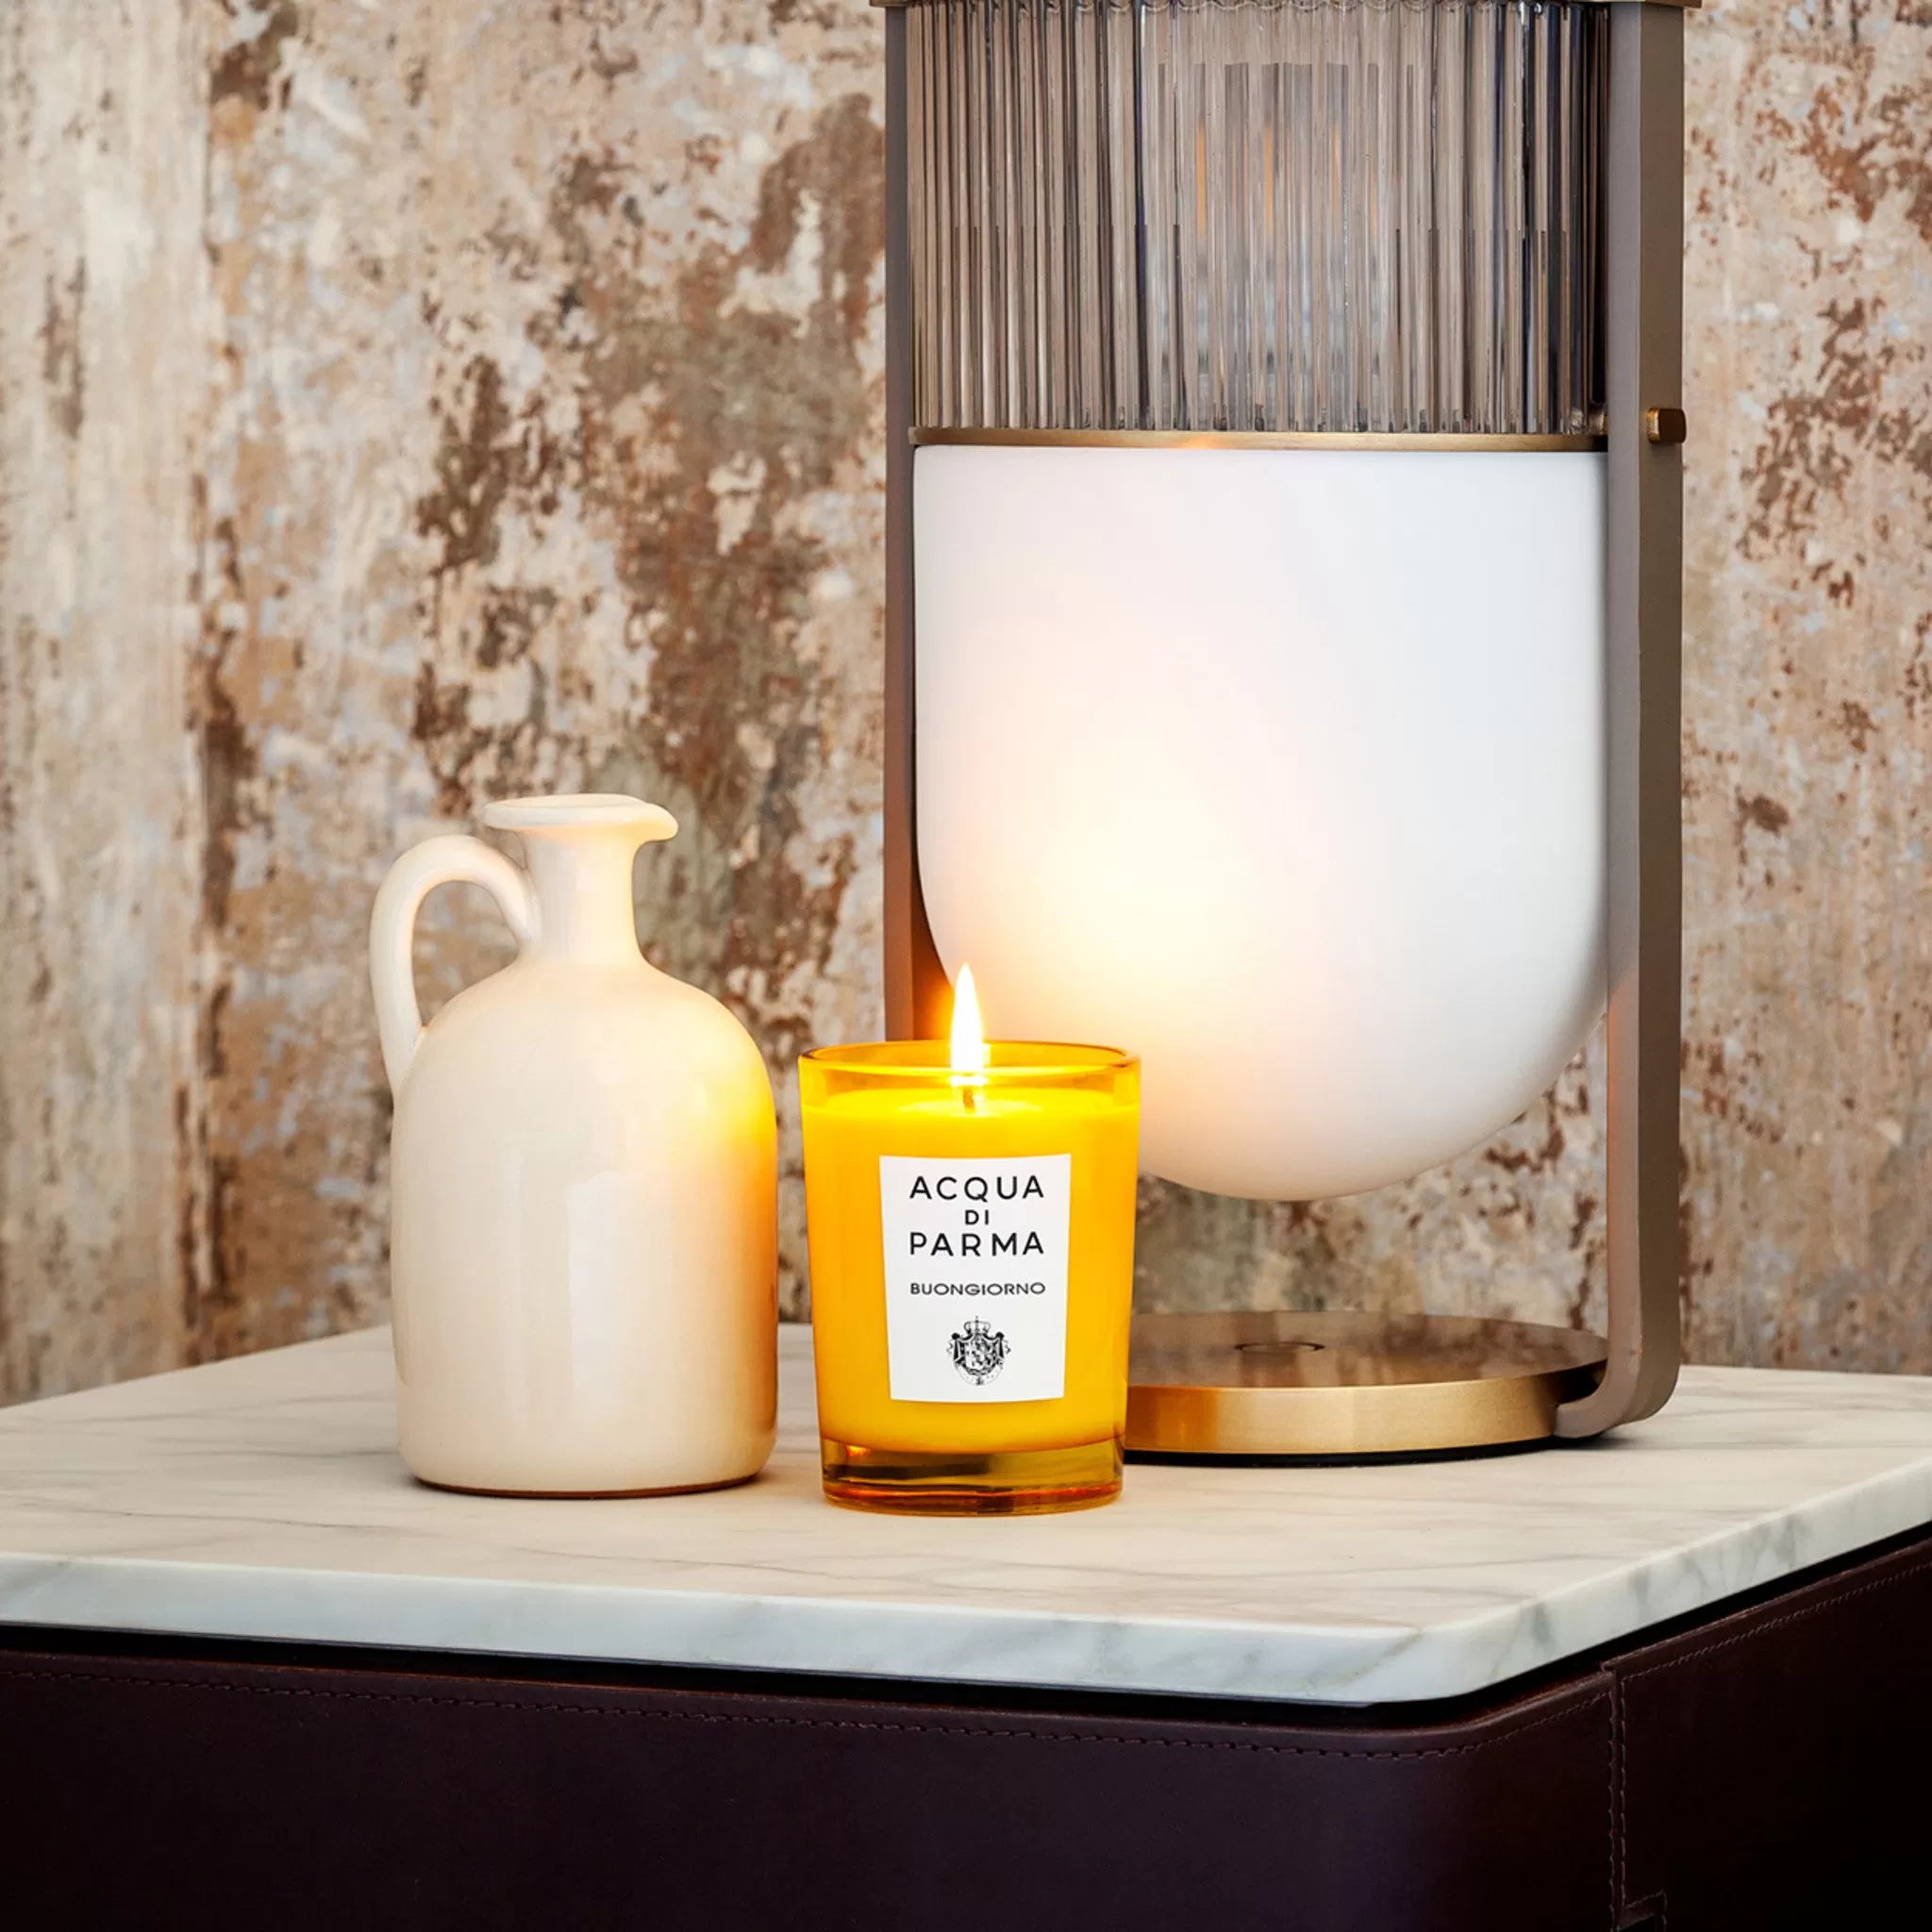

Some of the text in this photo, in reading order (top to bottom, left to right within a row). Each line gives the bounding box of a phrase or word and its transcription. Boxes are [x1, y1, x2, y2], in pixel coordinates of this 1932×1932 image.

[908, 1174, 1044, 1203] ACQUA
[964, 1208, 990, 1225] DI
[909, 1231, 1044, 1257] PARMA
[909, 1282, 1046, 1296] BUONGIORNO
